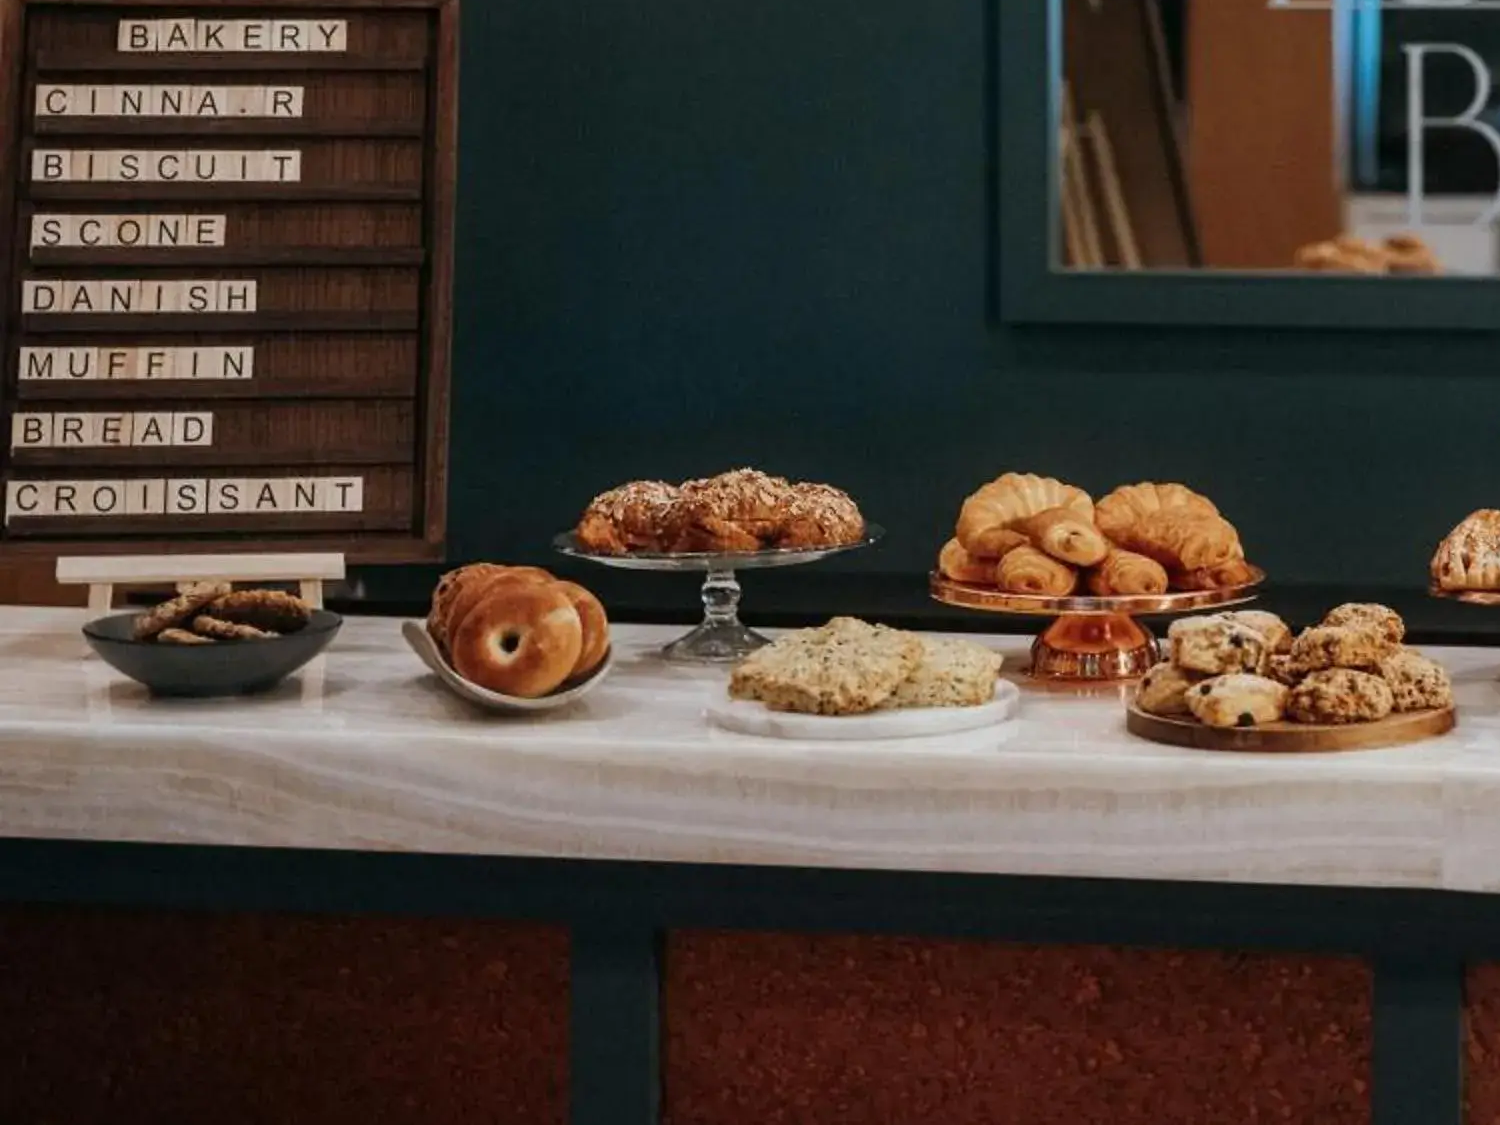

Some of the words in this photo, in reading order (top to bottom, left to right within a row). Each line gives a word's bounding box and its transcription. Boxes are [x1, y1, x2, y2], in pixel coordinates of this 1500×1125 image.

[129, 24, 340, 49] BAKERY
[43, 155, 293, 179] BISCUIT
[41, 220, 217, 244] SCONE
[32, 286, 248, 311] DANISH
[28, 352, 245, 377] MUFFIN
[23, 417, 206, 443] BREAD
[15, 482, 354, 512] CROISSANT
